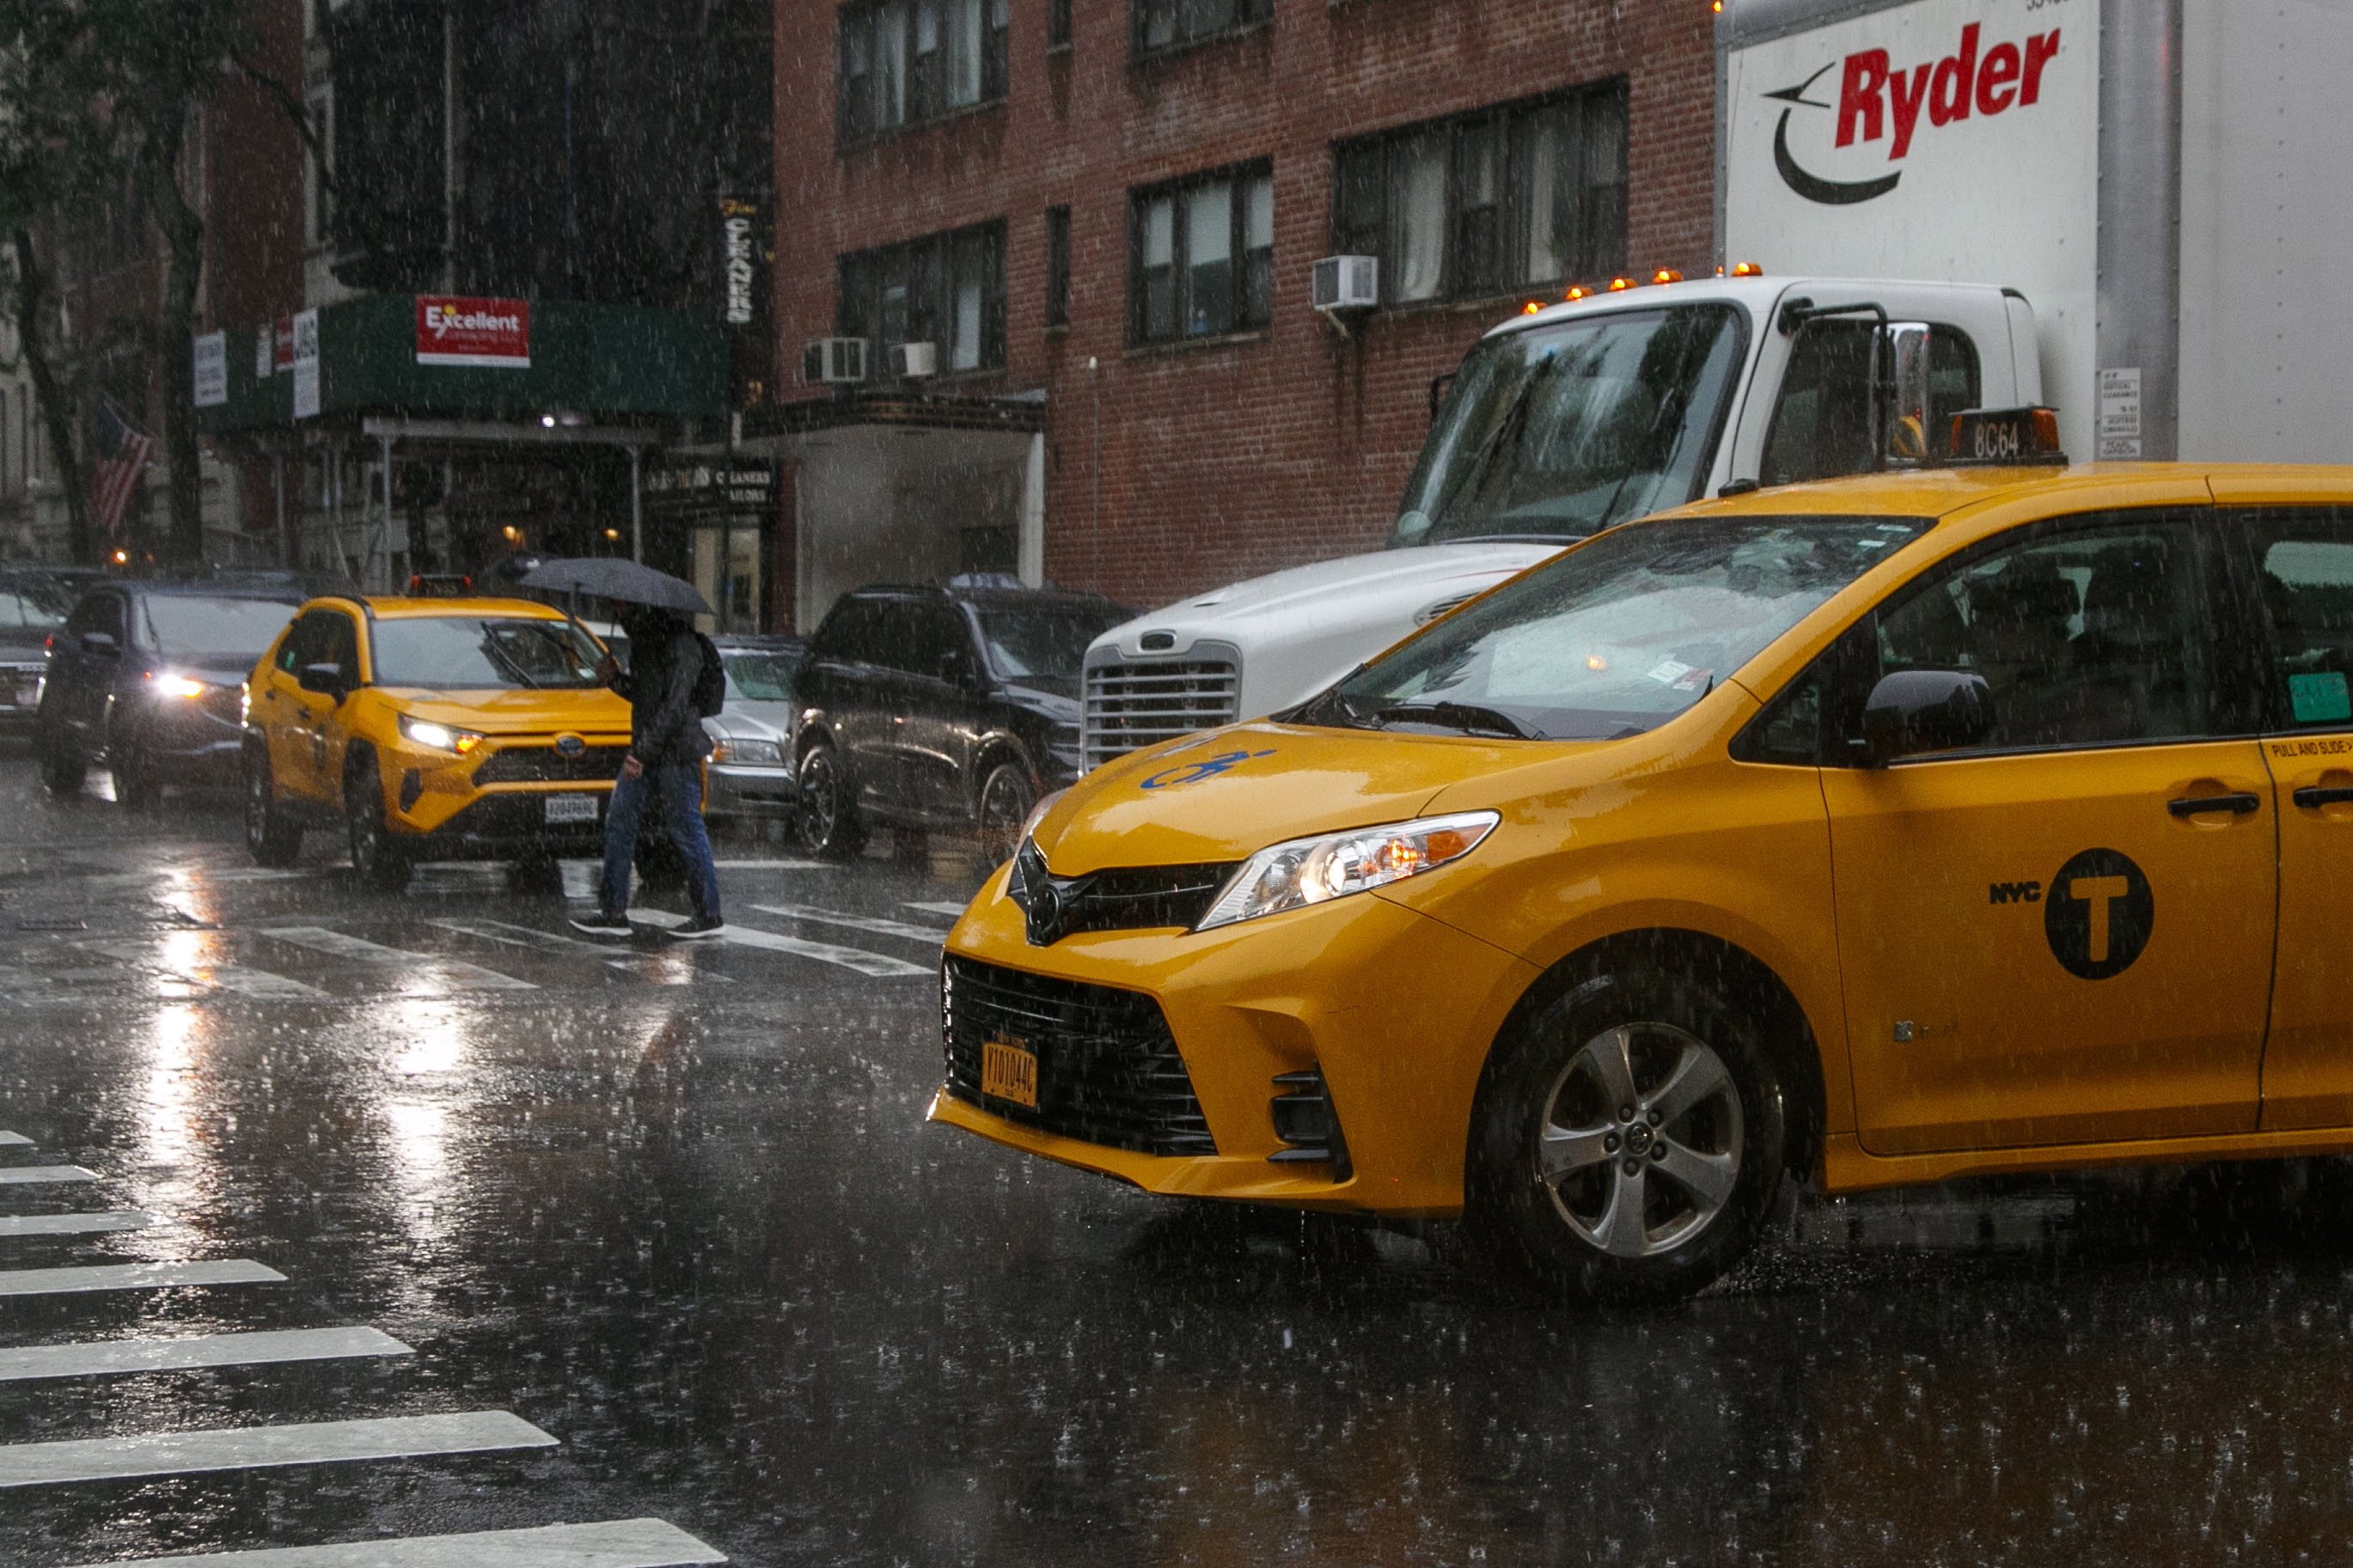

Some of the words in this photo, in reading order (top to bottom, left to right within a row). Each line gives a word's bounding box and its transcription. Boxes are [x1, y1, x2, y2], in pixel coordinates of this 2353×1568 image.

[1834, 21, 2062, 162] Ryder
[725, 218, 752, 323] CLEANERS
[425, 304, 520, 340] Excellent
[1975, 422, 2019, 458] 8C64
[716, 471, 770, 485] CEANERS
[720, 488, 766, 502] AILORS
[2271, 744, 2298, 757] PULL
[2299, 742, 2319, 755] AND
[2319, 741, 2347, 754] SLIDE
[1989, 881, 2041, 904] NYC
[2070, 876, 2130, 962] T
[987, 1045, 1034, 1093] Y101044C
